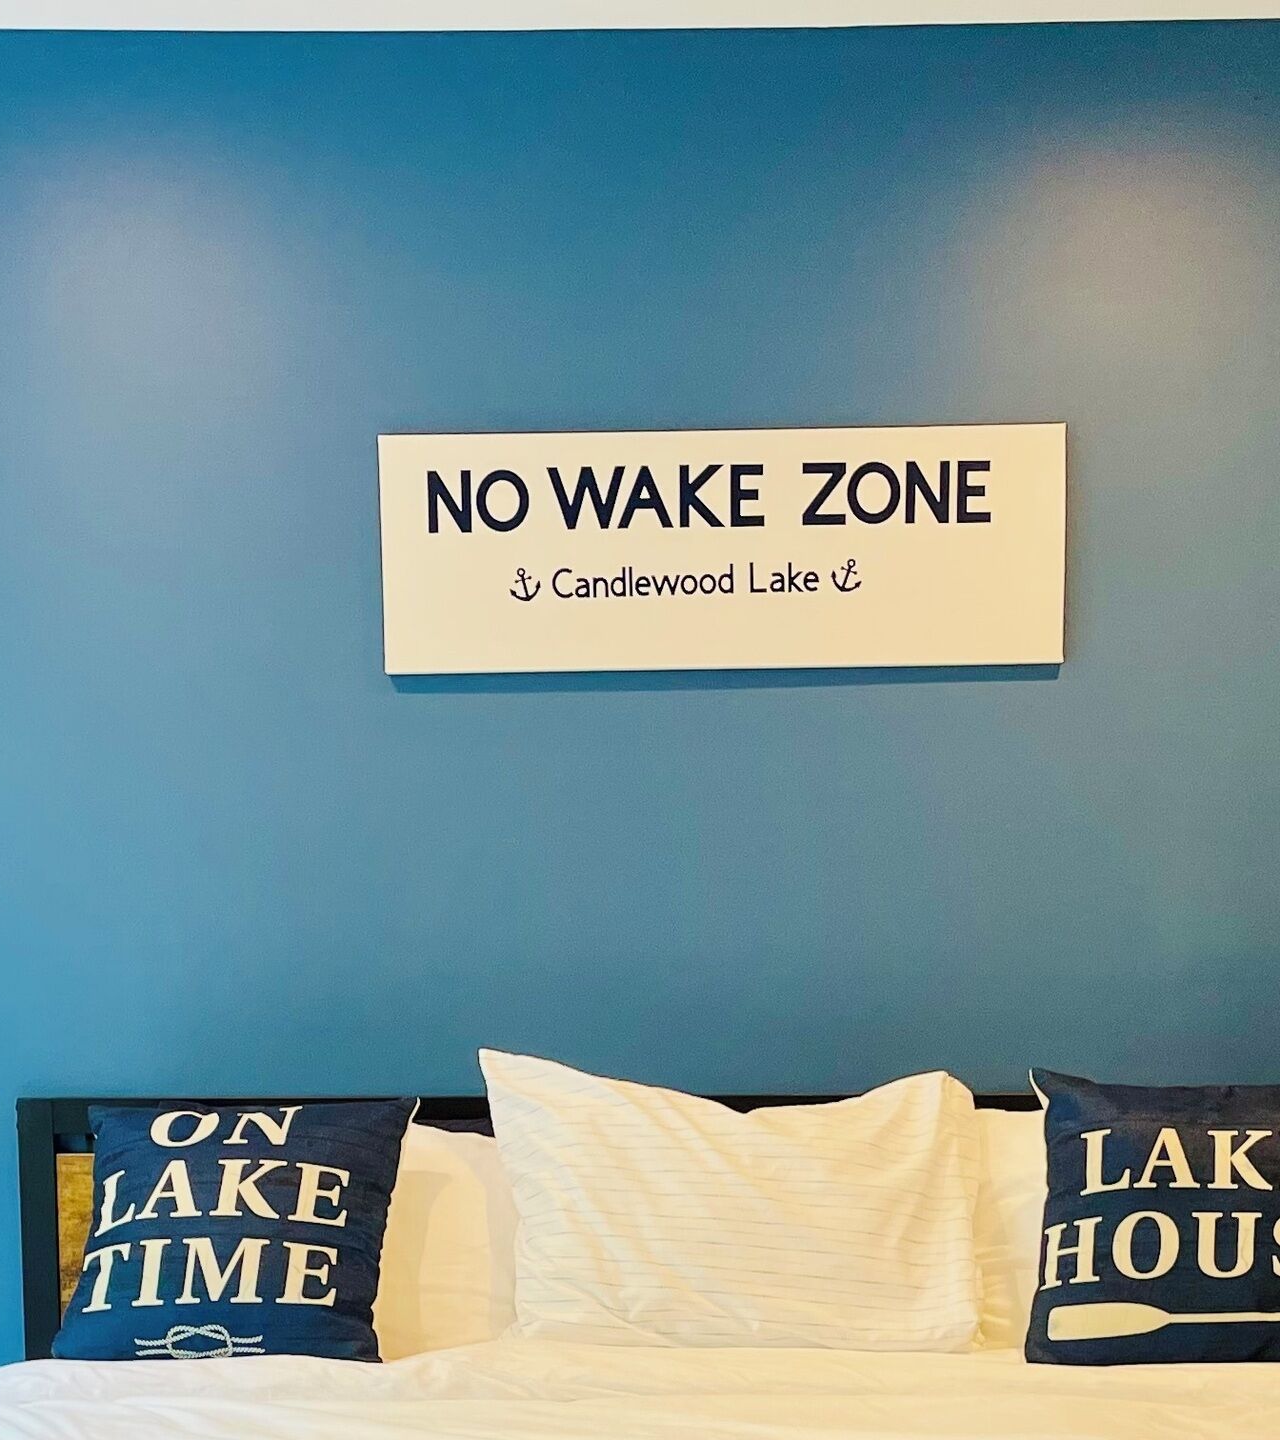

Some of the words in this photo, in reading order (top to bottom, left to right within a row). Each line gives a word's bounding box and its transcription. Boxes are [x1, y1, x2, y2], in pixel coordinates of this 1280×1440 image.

[426, 469, 529, 533] NO
[546, 463, 765, 530] WAKE
[801, 460, 992, 526] ZONE
[551, 563, 735, 600] Candlewood
[749, 561, 820, 594] Lake
[150, 1105, 303, 1147] ON
[94, 1158, 351, 1238] LAKE
[81, 1236, 339, 1314] TIME
